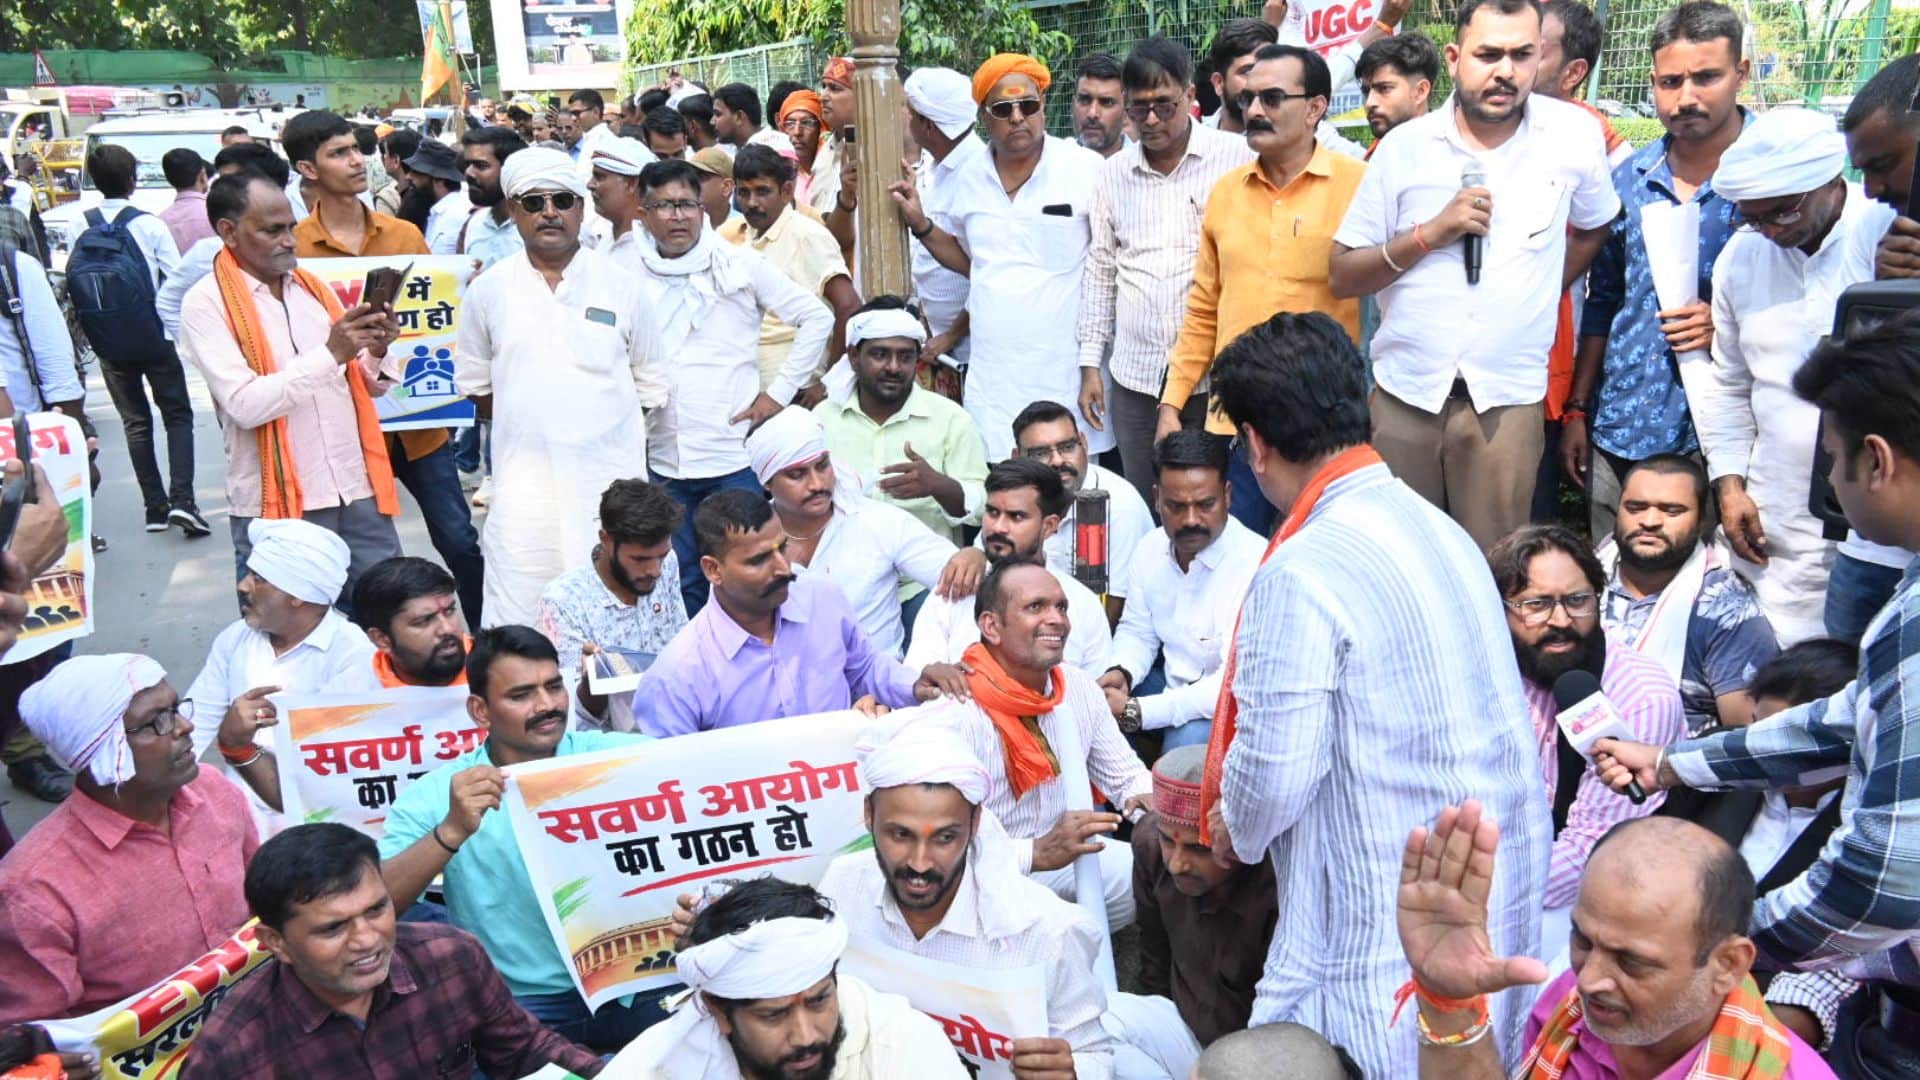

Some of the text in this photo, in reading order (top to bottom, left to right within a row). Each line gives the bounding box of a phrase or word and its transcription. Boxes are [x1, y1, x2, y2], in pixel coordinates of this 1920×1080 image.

[1304, 0, 1373, 44] UGC
[407, 275, 432, 301] में
[424, 301, 455, 331] हो
[300, 725, 423, 776] सवर्ण
[353, 774, 397, 809] का
[537, 760, 859, 843] सवर्ण आयोग
[606, 805, 812, 875] का गठन हो
